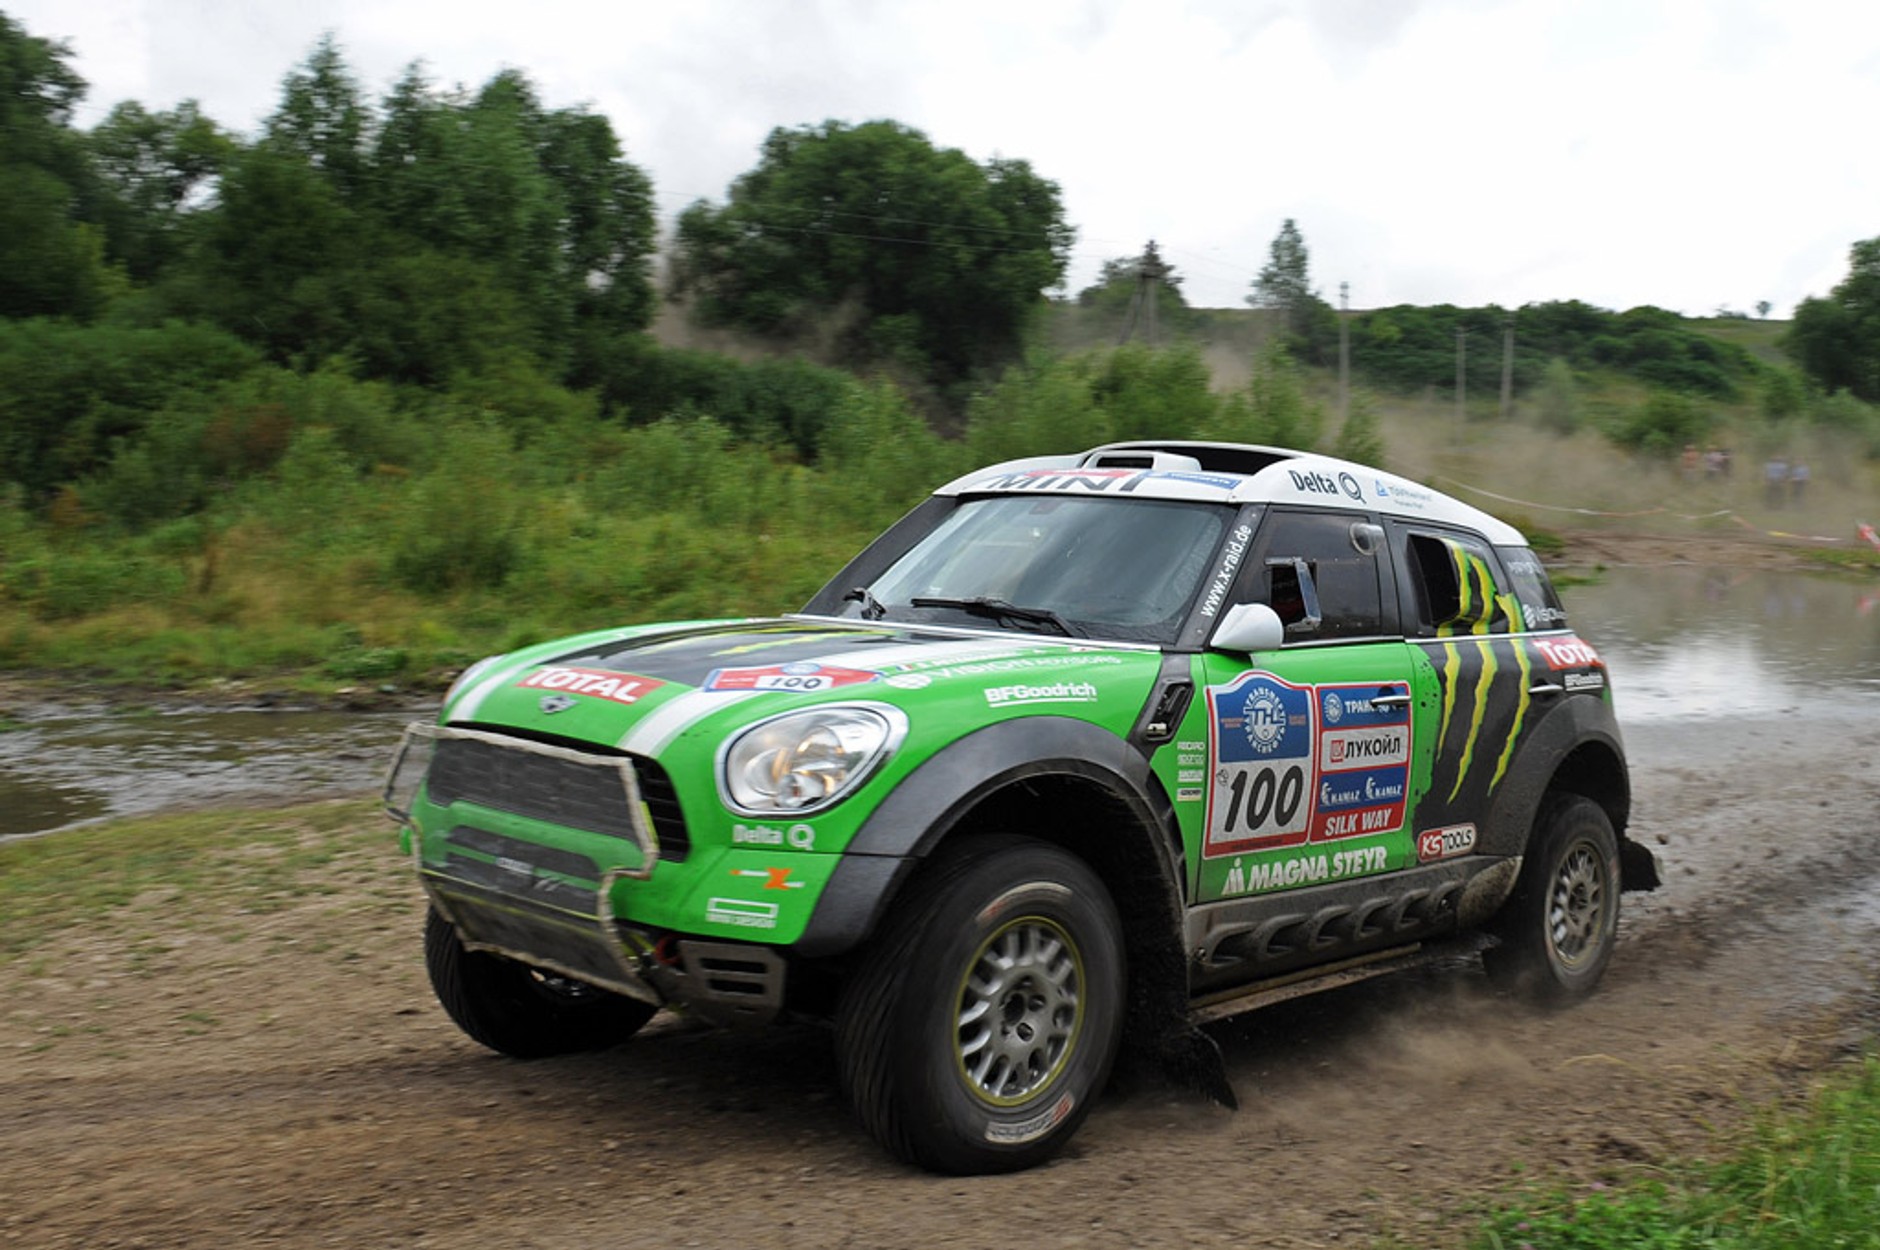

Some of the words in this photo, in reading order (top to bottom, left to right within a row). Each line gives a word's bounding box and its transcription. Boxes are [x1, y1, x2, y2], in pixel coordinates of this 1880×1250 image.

[986, 470, 1149, 492] MINI
[1288, 470, 1339, 495] Delta
[1338, 472, 1367, 504] Q
[1200, 525, 1252, 617] www.x-raid.de
[526, 667, 642, 703] TOTAL
[770, 676, 822, 690] 100
[984, 682, 1097, 703] BFGoodrich
[1345, 734, 1401, 759] ЛУКОЙЛ
[1224, 765, 1303, 832] 100
[1325, 813, 1358, 836] SILK
[1361, 808, 1392, 830] WAY
[732, 824, 784, 845] Delta
[786, 823, 816, 852] Q
[1247, 858, 1328, 891] MAGNA
[1332, 847, 1388, 877] STEYR
